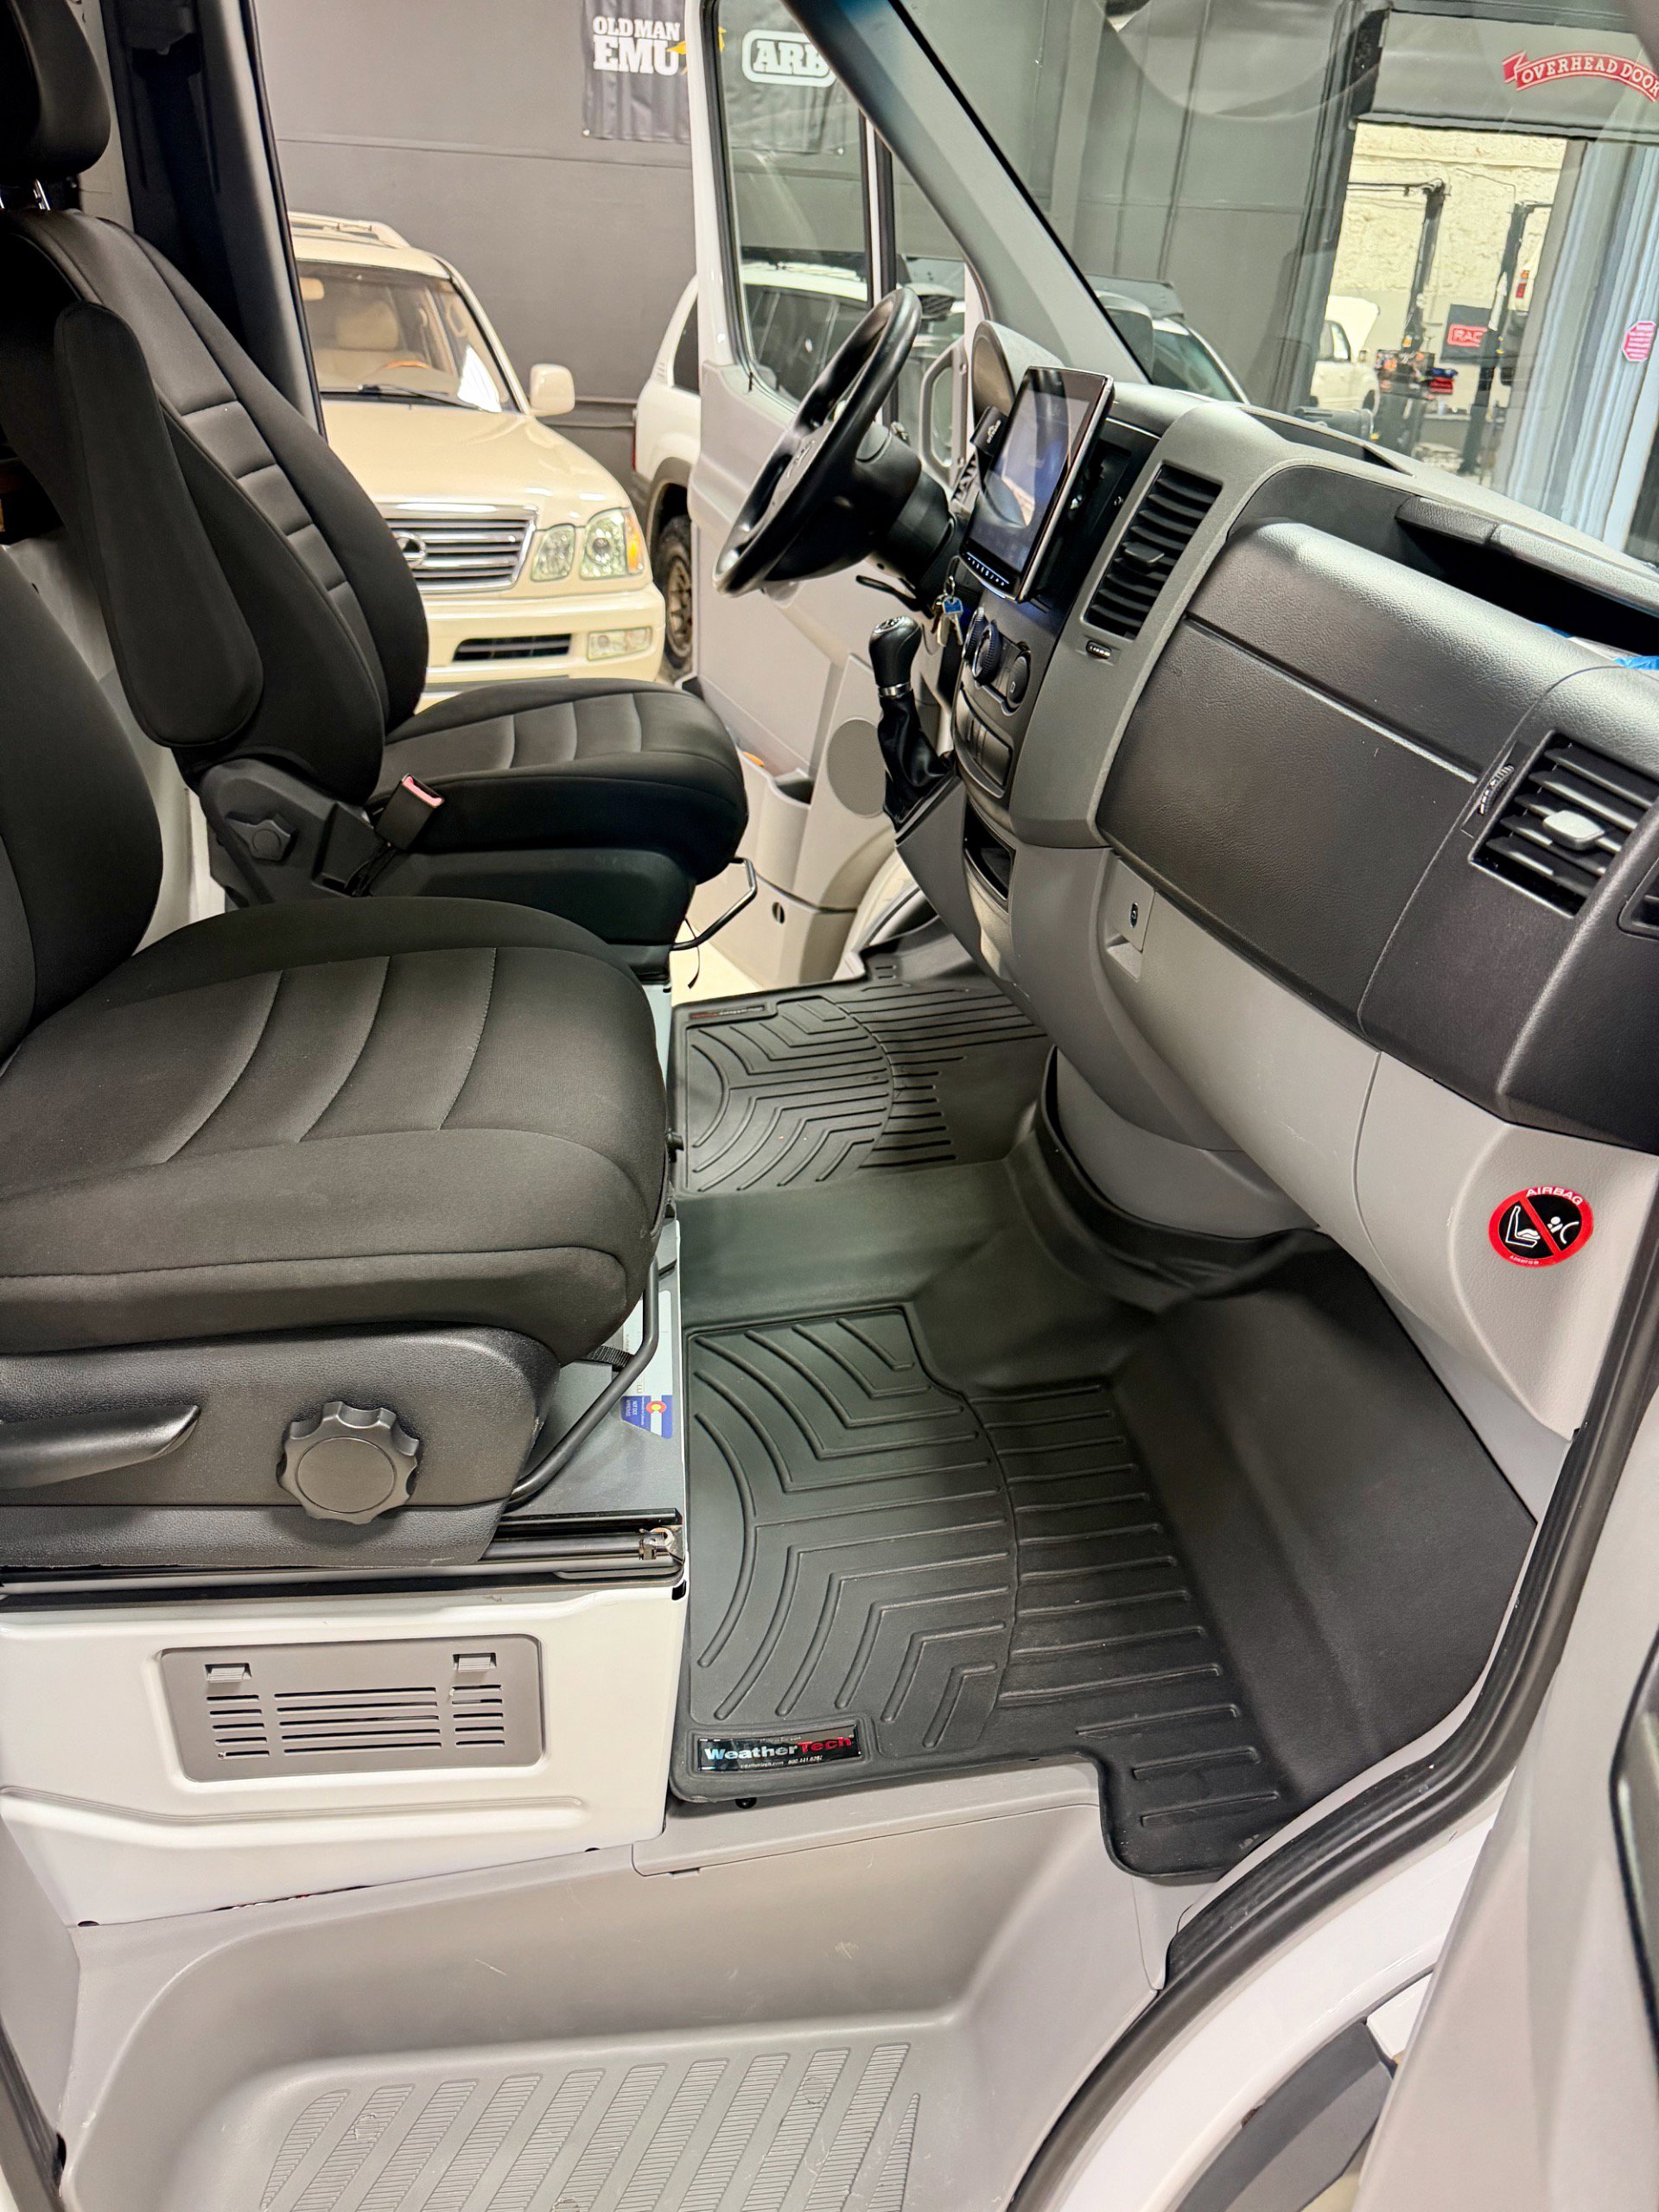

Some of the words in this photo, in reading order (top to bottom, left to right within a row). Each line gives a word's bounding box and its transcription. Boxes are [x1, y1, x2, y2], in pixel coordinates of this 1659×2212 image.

[593, 16, 633, 37] OLD
[634, 19, 680, 41] MAN
[594, 35, 679, 76] EMU
[753, 40, 830, 77] ARB
[1522, 55, 1618, 84] OVERHEAD
[1526, 1186, 1583, 1205] AIRBAG
[704, 1736, 852, 1760] WeatherTech
